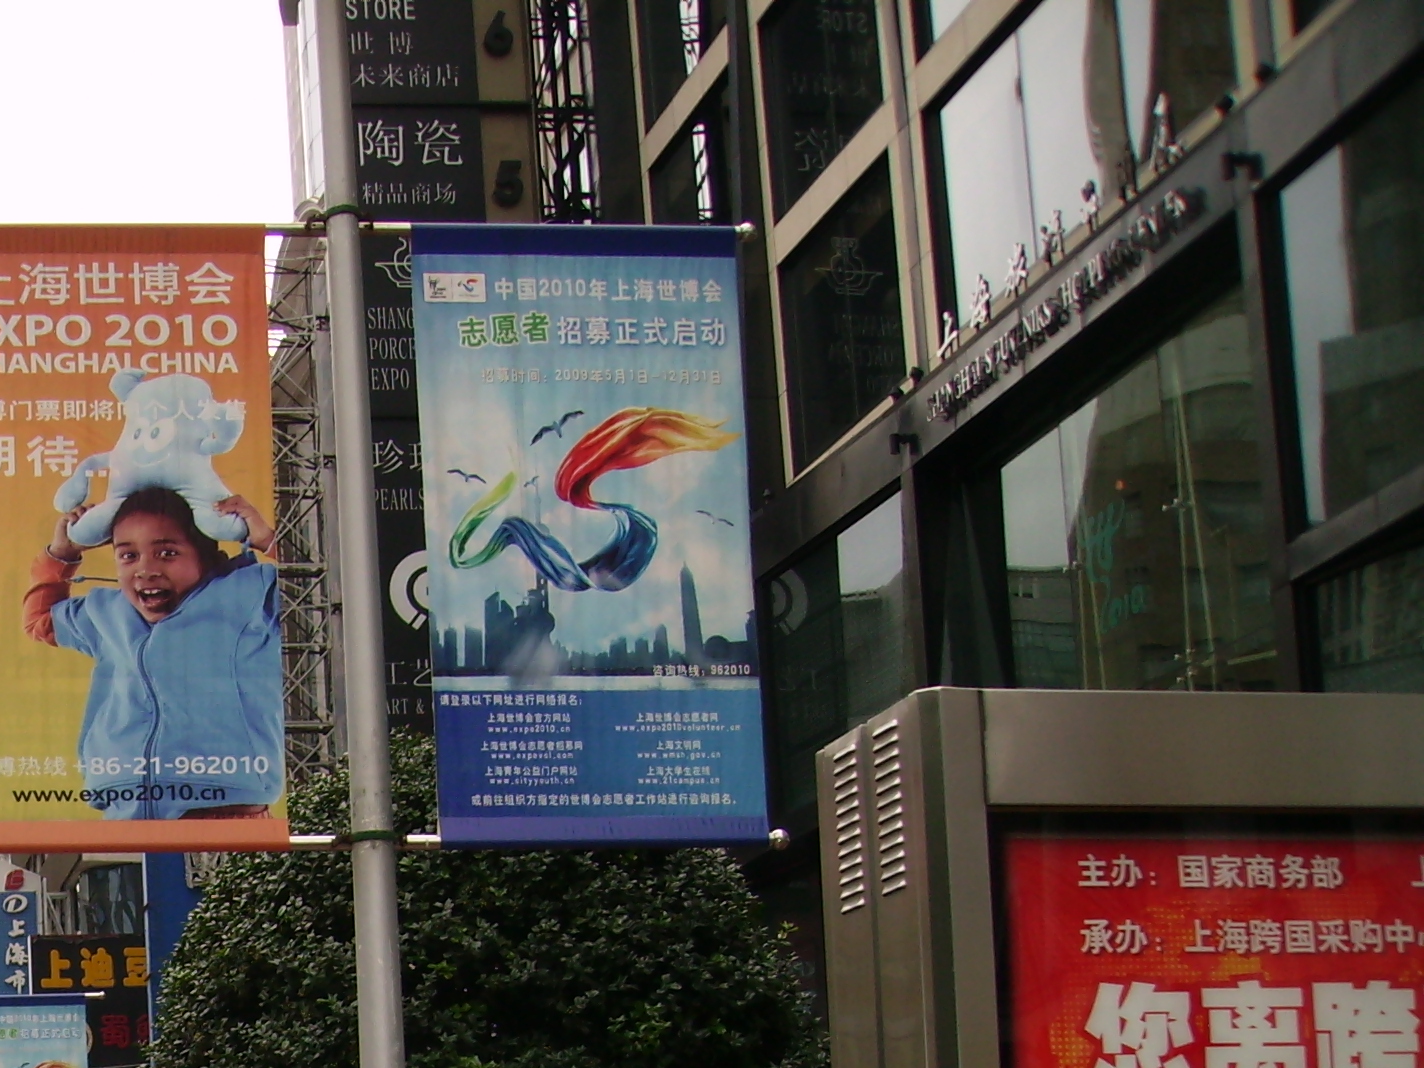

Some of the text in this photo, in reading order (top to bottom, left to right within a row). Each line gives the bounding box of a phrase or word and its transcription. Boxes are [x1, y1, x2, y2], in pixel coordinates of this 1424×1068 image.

[345, 0, 416, 21] STORE
[484, 10, 514, 57] 6
[358, 119, 463, 166] 陶瓷
[362, 182, 457, 206] 精品商场
[492, 160, 525, 208] 5
[494, 277, 723, 303] 中国2010年上海世博会
[104, 314, 238, 347] 2010
[139, 352, 238, 374] CHINA
[371, 367, 410, 391] EXPO
[72, 755, 270, 776] +86-21-962010
[12, 783, 226, 806] www.expo2010.cn
